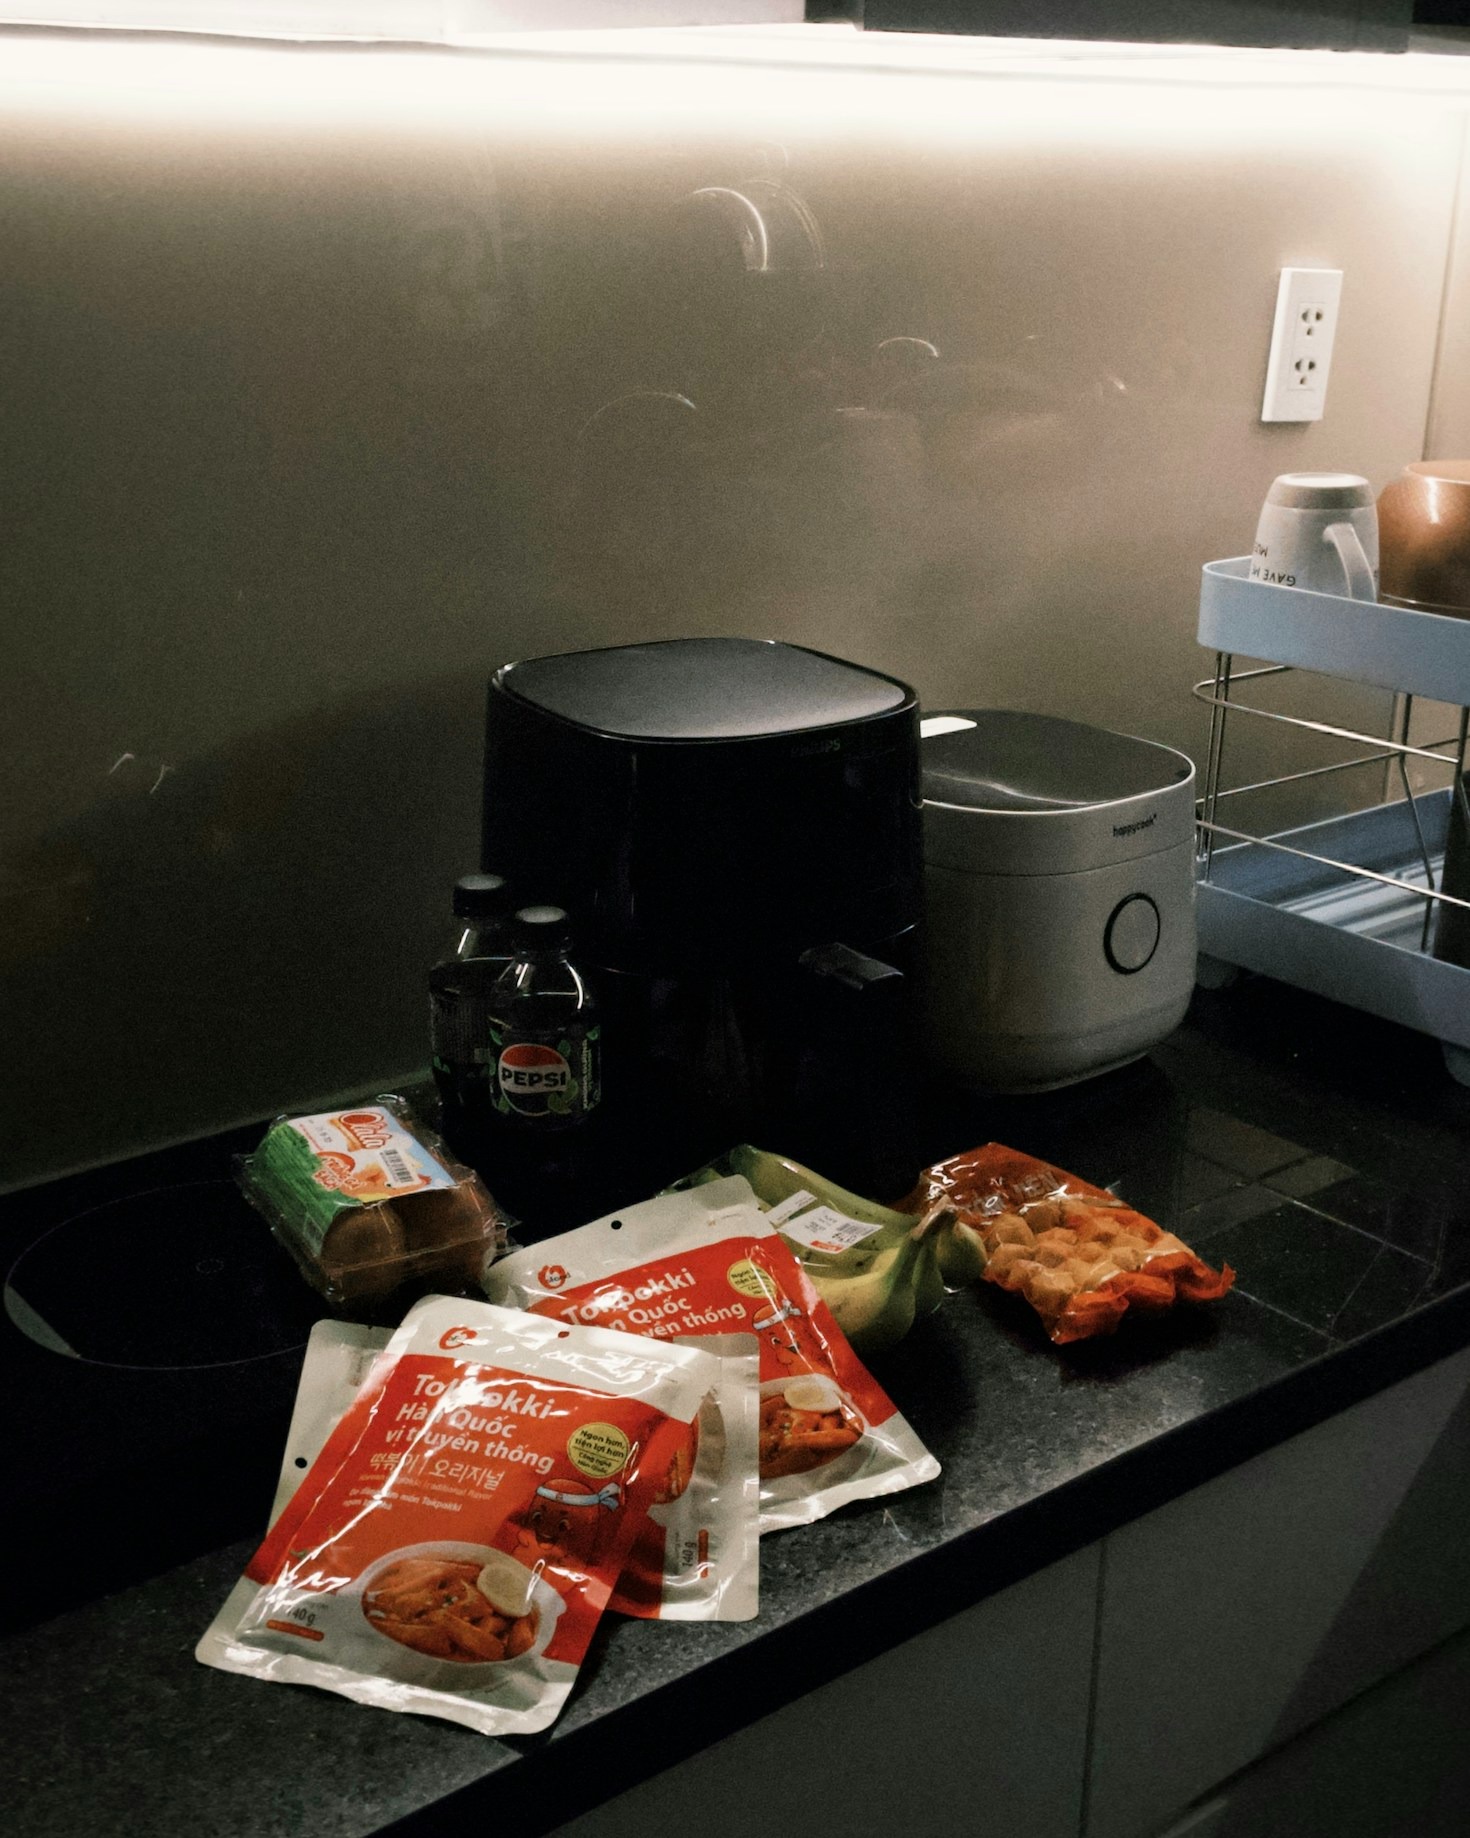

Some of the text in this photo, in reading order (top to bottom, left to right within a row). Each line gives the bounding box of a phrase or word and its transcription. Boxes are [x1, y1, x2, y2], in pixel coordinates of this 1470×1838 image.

[1263, 569, 1296, 587] GAVE
[501, 1068, 566, 1087] PEPSI
[628, 1295, 692, 1324] Quốc
[683, 1302, 747, 1329] thống
[414, 1374, 555, 1419] Tookki
[449, 1408, 517, 1438] Quốc
[581, 1430, 604, 1442] Ngon
[385, 1425, 555, 1475] vị tuyền thống
[429, 1459, 505, 1491] 오리지널
[682, 1550, 694, 1567] 140
